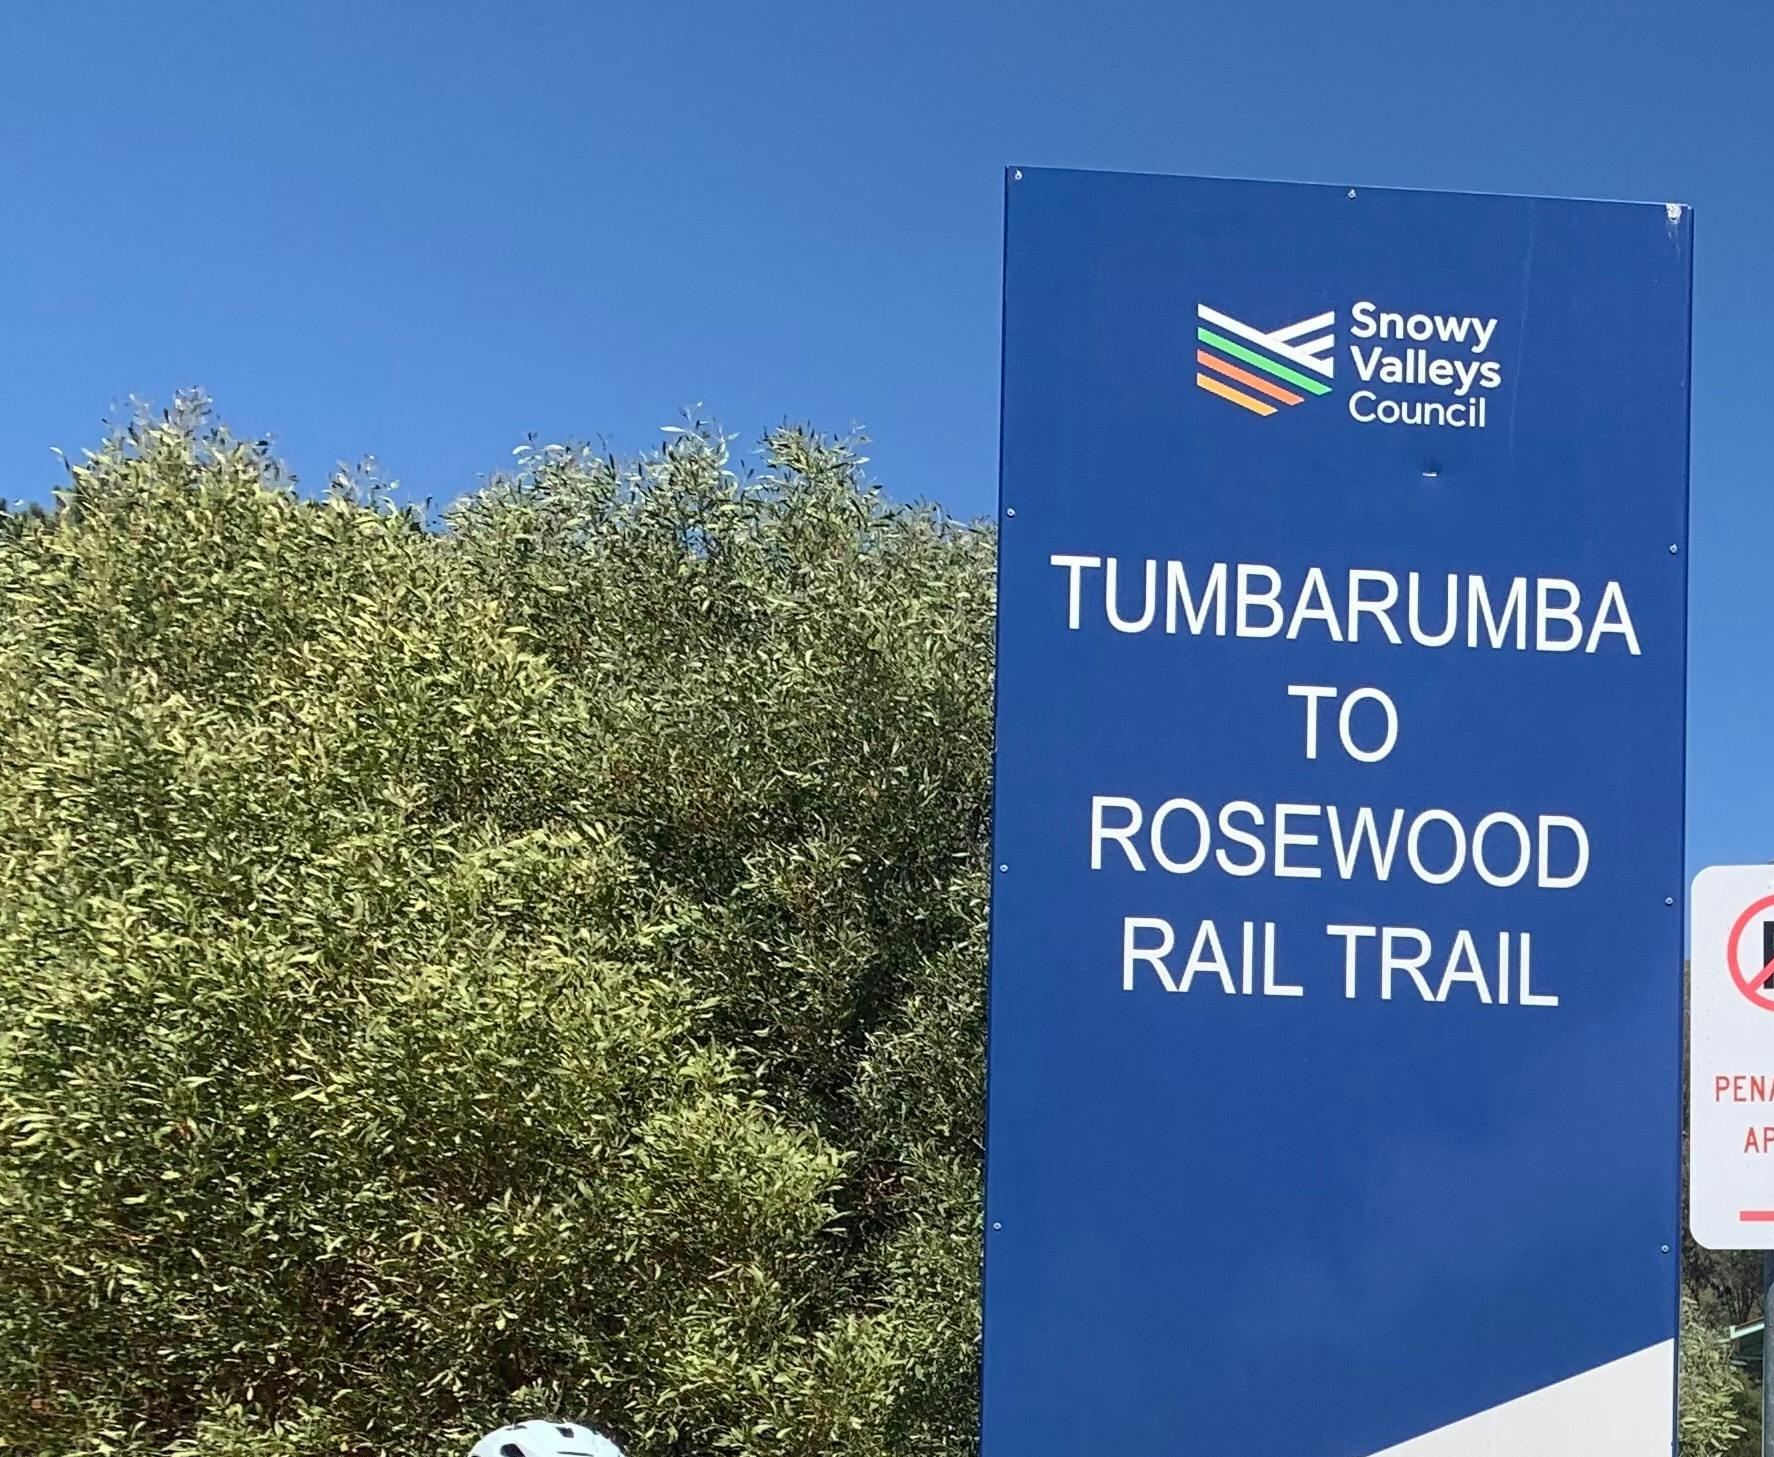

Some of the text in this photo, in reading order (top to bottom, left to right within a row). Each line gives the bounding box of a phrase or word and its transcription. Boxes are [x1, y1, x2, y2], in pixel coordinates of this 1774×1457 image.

[1350, 301, 1498, 350] Snowy
[1349, 391, 1486, 428] Council
[1350, 345, 1502, 395] Valleys
[1050, 554, 1642, 656] TUMBARUMBA
[1287, 684, 1398, 763] TO
[1091, 795, 1590, 889] ROSEWOOD
[1121, 916, 1559, 1007] RAIL TRAIL
